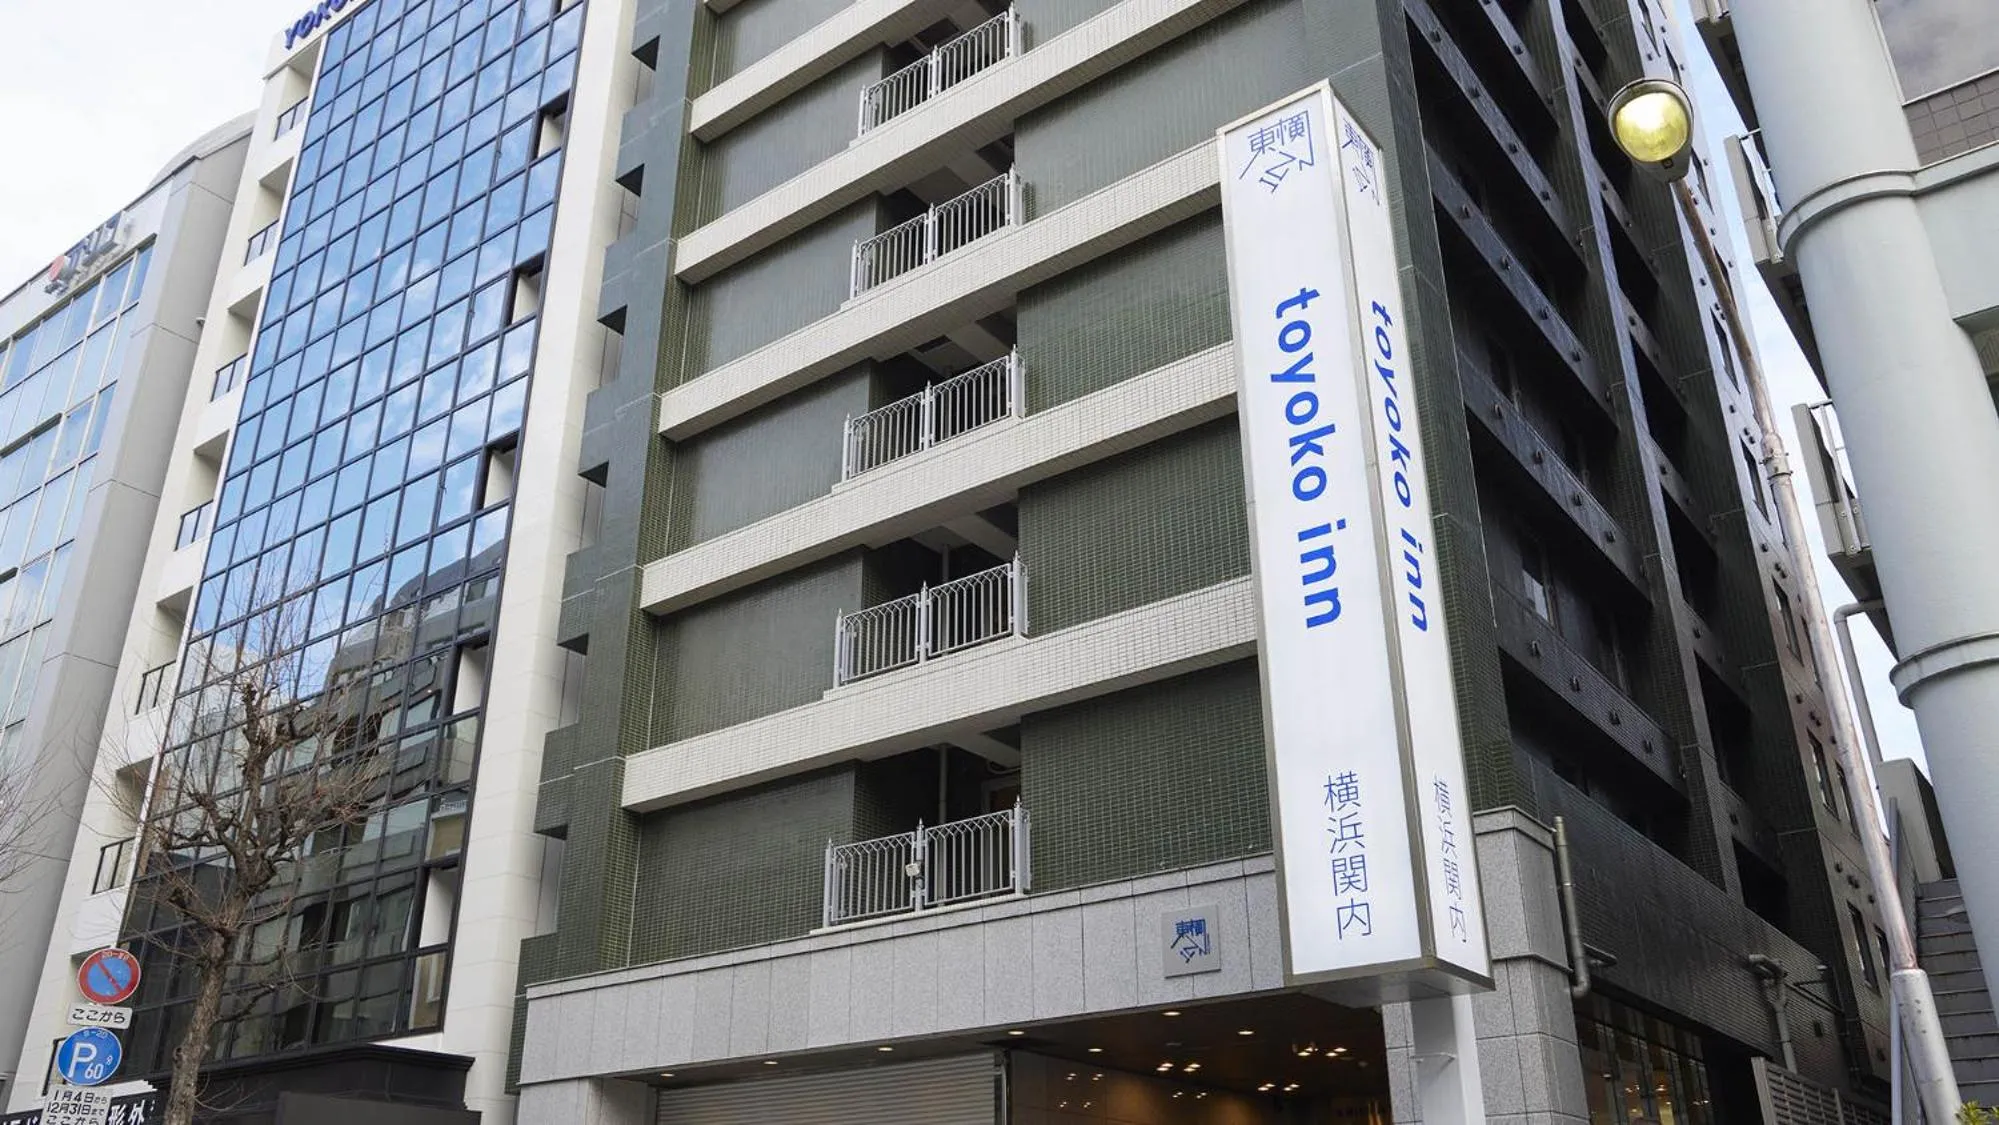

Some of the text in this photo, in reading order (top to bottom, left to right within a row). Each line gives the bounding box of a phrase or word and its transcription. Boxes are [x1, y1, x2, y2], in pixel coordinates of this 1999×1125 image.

[1271, 286, 1346, 629] toyoko inn
[1371, 299, 1428, 633] toyoko inn
[1323, 770, 1372, 940] 横浜関内
[67, 1042, 97, 1078] P
[72, 1008, 126, 1024] ここから
